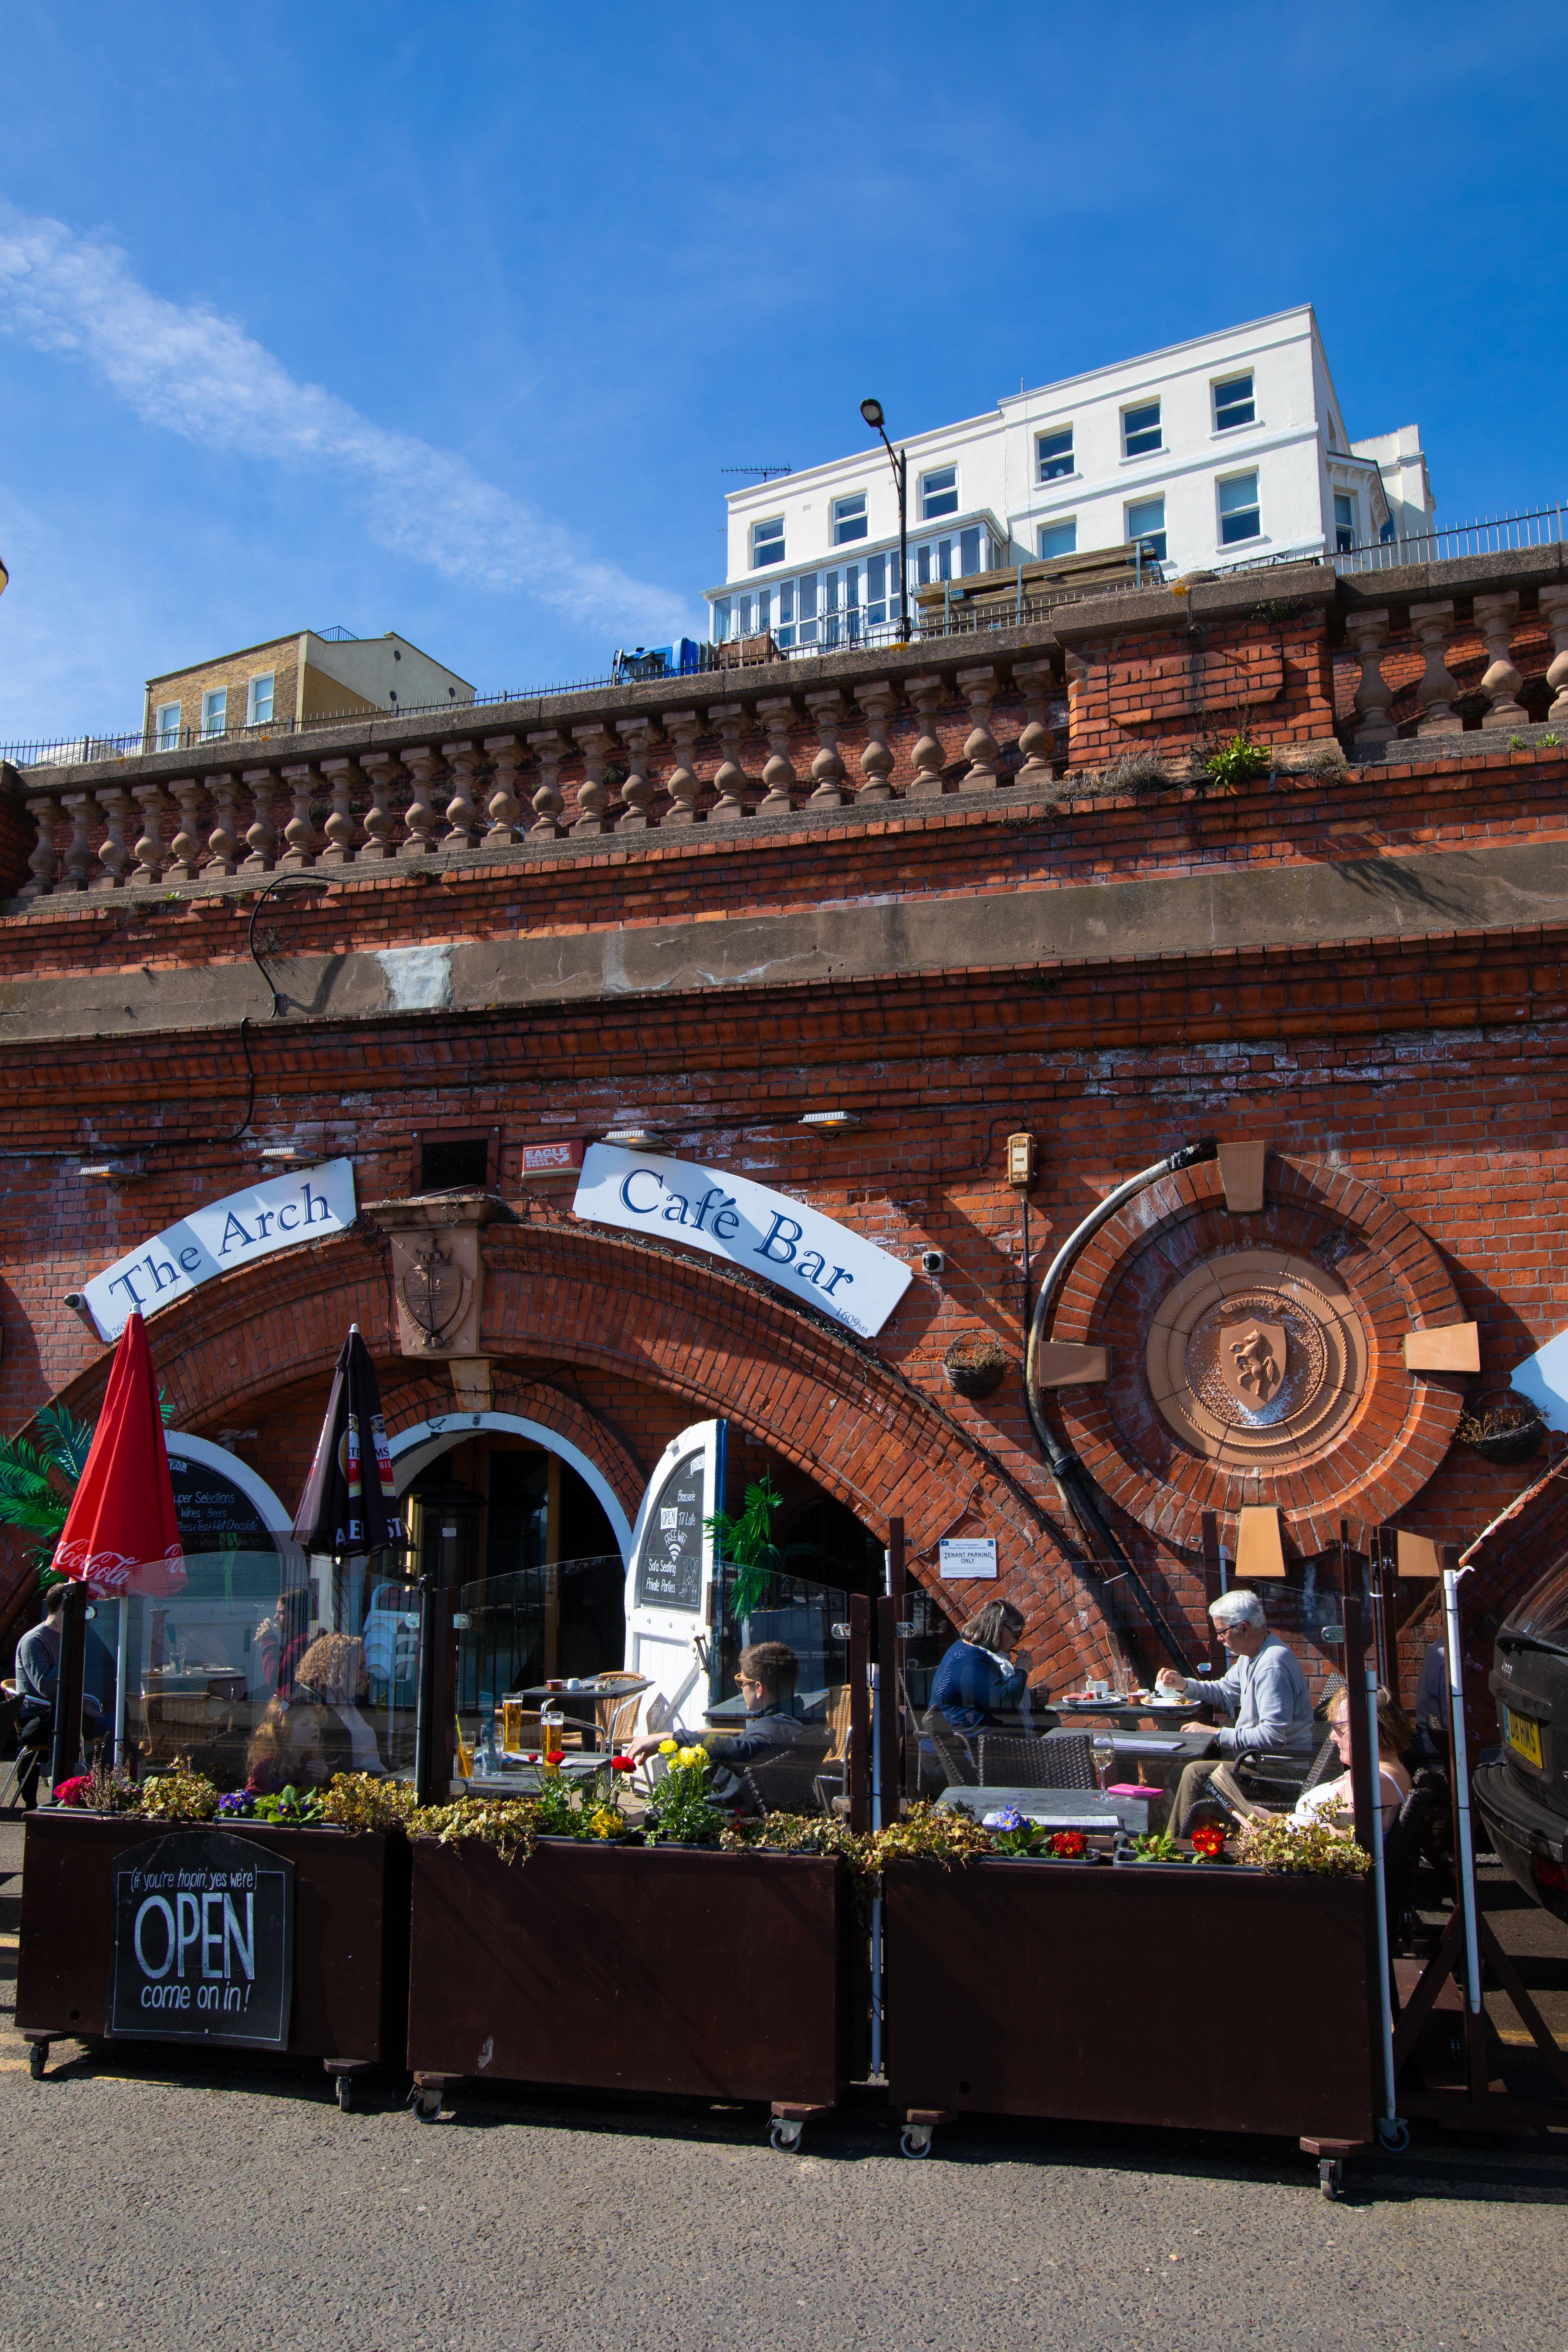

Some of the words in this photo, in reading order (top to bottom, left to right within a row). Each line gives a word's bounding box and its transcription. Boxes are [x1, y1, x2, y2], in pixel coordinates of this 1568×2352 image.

[525, 1147, 568, 1159] EAGLE
[619, 1169, 739, 1240] Café
[753, 1210, 854, 1297] Bar
[109, 1247, 201, 1304] The
[218, 1182, 332, 1257] Arch
[1230, 1298, 1273, 1309] INVICTA
[172, 1492, 192, 1507] uper
[195, 1491, 235, 1504] Selections
[677, 1490, 696, 1502] Brasserie
[181, 1507, 200, 1518] Wines
[207, 1508, 227, 1518] Beers
[662, 1510, 675, 1526] OPEN
[685, 1511, 696, 1526] Late
[197, 1520, 207, 1531] Tea
[213, 1519, 226, 1531] Hot
[227, 1519, 258, 1531] Chocolate
[664, 1529, 677, 1547] FREE
[677, 1530, 687, 1546] WiFi
[84, 1551, 141, 1585] Cola
[648, 1558, 659, 1572] Sofa
[660, 1560, 676, 1576] Seating
[646, 1577, 660, 1592] Private
[661, 1579, 675, 1593] Parties
[1209, 1786, 1217, 1795] he
[143, 1871, 174, 1891] you're
[209, 1871, 227, 1890] yes
[134, 1892, 254, 1979] OPEN
[141, 1985, 190, 2009] come
[197, 1985, 219, 2010] on
